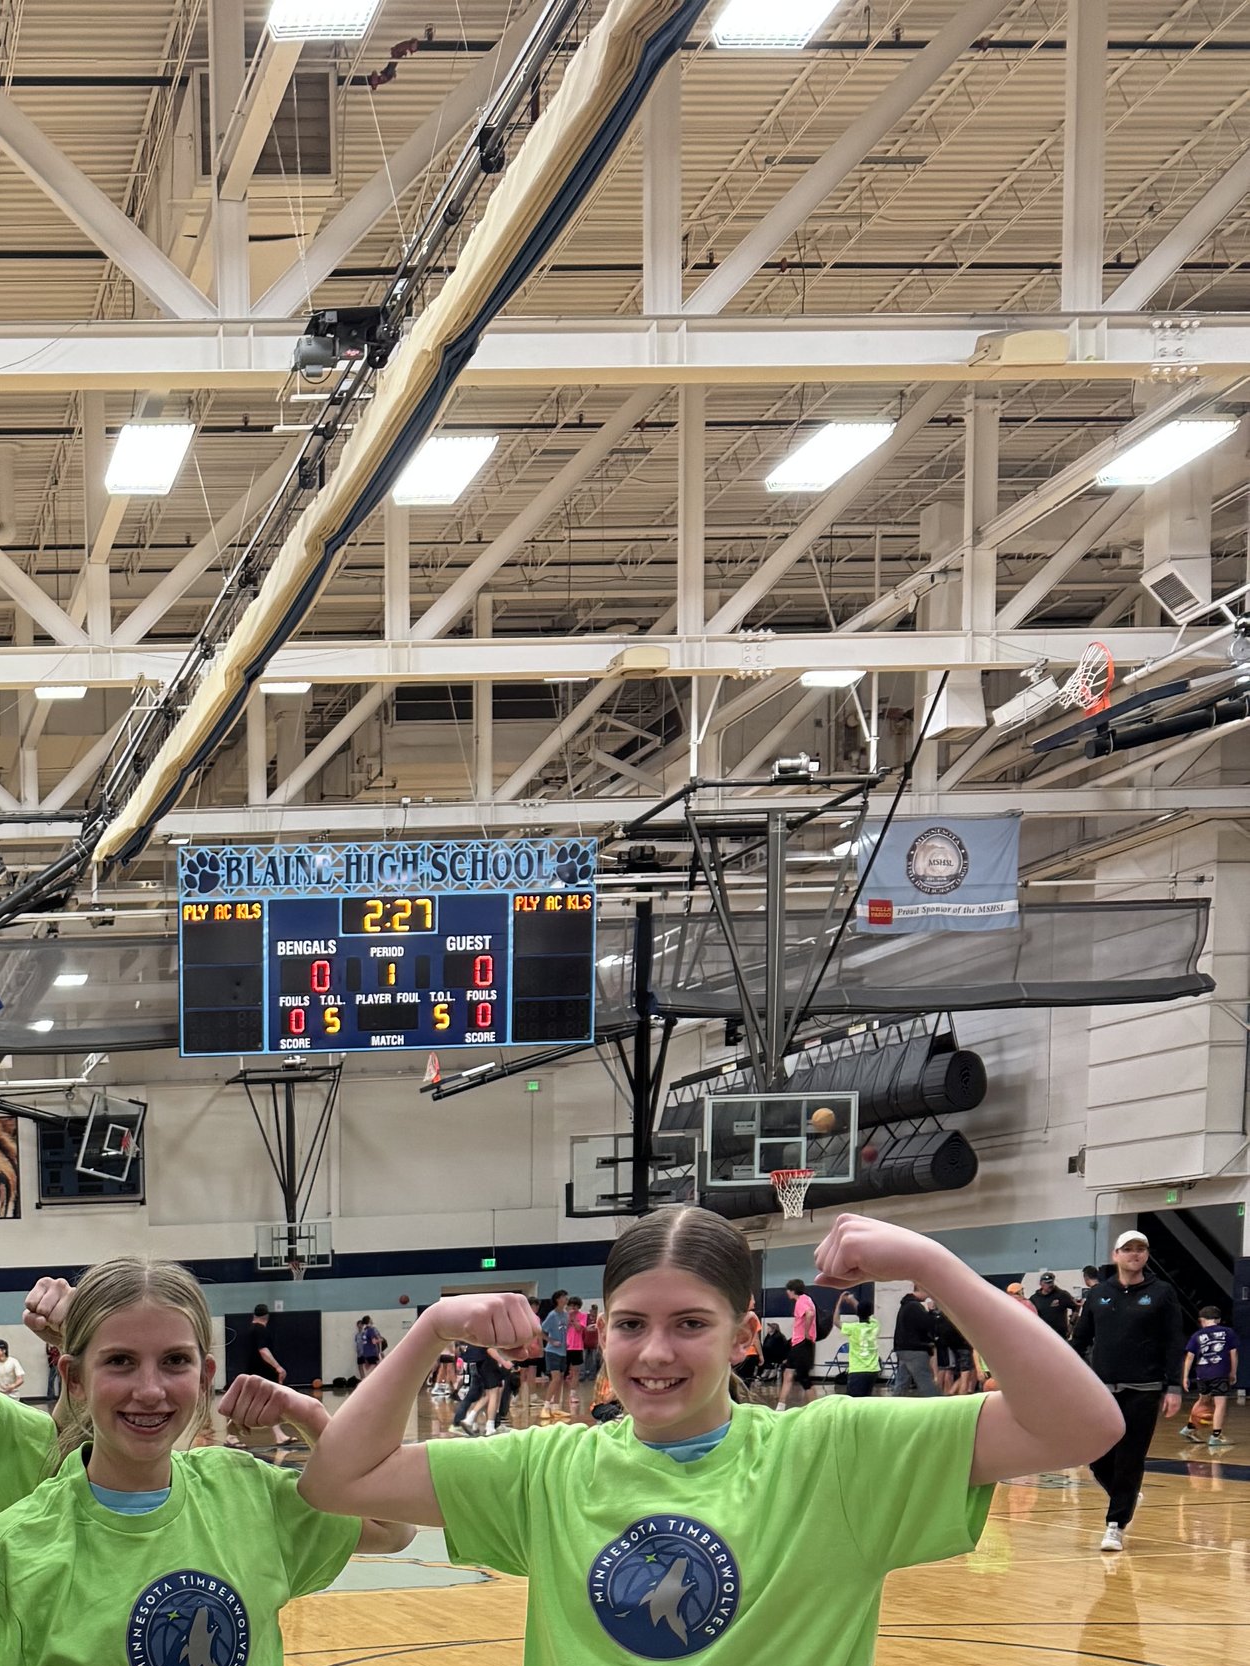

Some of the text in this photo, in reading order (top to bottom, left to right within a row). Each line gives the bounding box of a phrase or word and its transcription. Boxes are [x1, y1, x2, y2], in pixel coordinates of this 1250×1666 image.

[225, 848, 550, 889] BLAINE HIGH SCHOOL
[184, 902, 262, 921] PLY AC KLS
[515, 893, 591, 912] PLY AC KLS
[897, 906, 919, 916] Proud
[921, 905, 951, 915] Sponsor
[951, 906, 961, 915] of
[963, 905, 975, 914] the
[363, 898, 432, 933] 2:27
[277, 940, 337, 956] BENGALS
[370, 946, 404, 958] PERIOD
[446, 935, 492, 952] GUEST
[311, 960, 331, 993] 0
[387, 963, 396, 986] 1
[473, 955, 493, 987] 0
[279, 995, 346, 1008] FOULS T.O.L.
[356, 991, 421, 1005] PLAYER FOUL
[429, 989, 497, 1003] T.O.L. FOULS
[289, 1007, 341, 1035] 0 5
[433, 1002, 492, 1030] 5 0
[280, 1037, 311, 1050] SCORE
[371, 1034, 405, 1047] MATCH
[465, 1031, 496, 1044] SCORE
[593, 1519, 735, 1636] MINNESOTA TIMBERWOLVES
